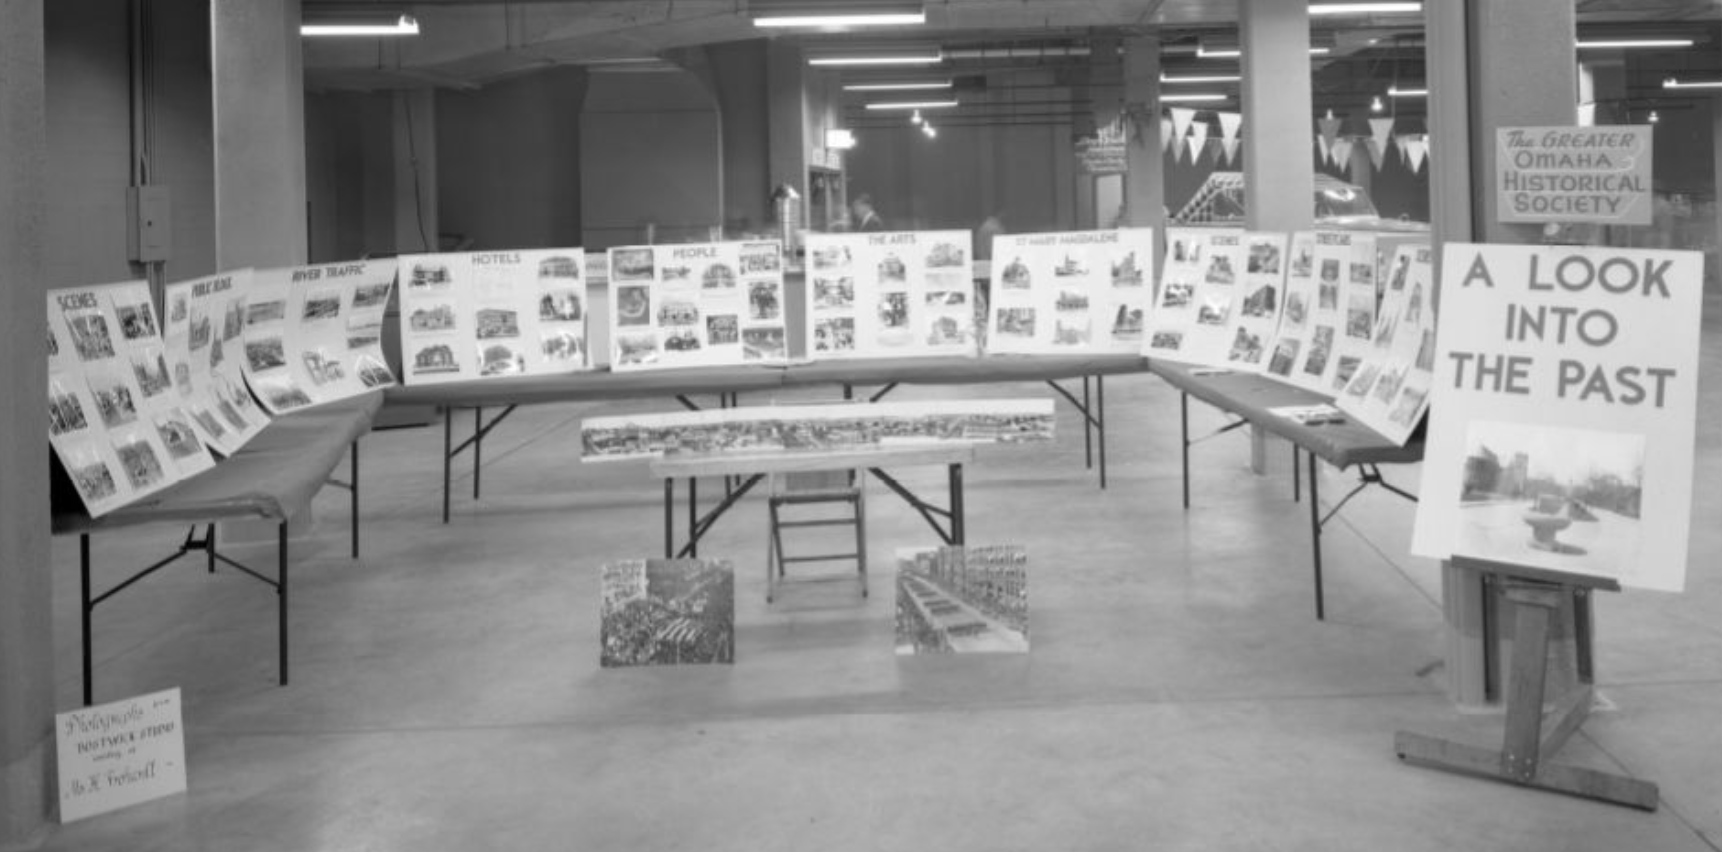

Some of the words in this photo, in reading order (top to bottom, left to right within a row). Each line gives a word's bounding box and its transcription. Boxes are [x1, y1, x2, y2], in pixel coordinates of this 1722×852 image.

[1506, 130, 1536, 148] The
[1541, 130, 1636, 149] GREATER
[1503, 171, 1646, 193] HISTORICAL
[1513, 193, 1622, 213] SOCIETY
[869, 234, 886, 246] THE
[890, 233, 917, 245] ARTS
[1059, 232, 1119, 245] MAGDALENE
[471, 252, 522, 266] HOTELS
[672, 246, 719, 260] PEOPLE
[291, 268, 322, 284] RIVER
[325, 264, 367, 279] TRAFFIC
[1462, 252, 1494, 288] A
[1528, 254, 1674, 299] LOOK
[57, 291, 98, 311] SCENES
[1505, 303, 1619, 347] INTO
[1448, 351, 1533, 395] THE
[1557, 359, 1677, 408] PAST
